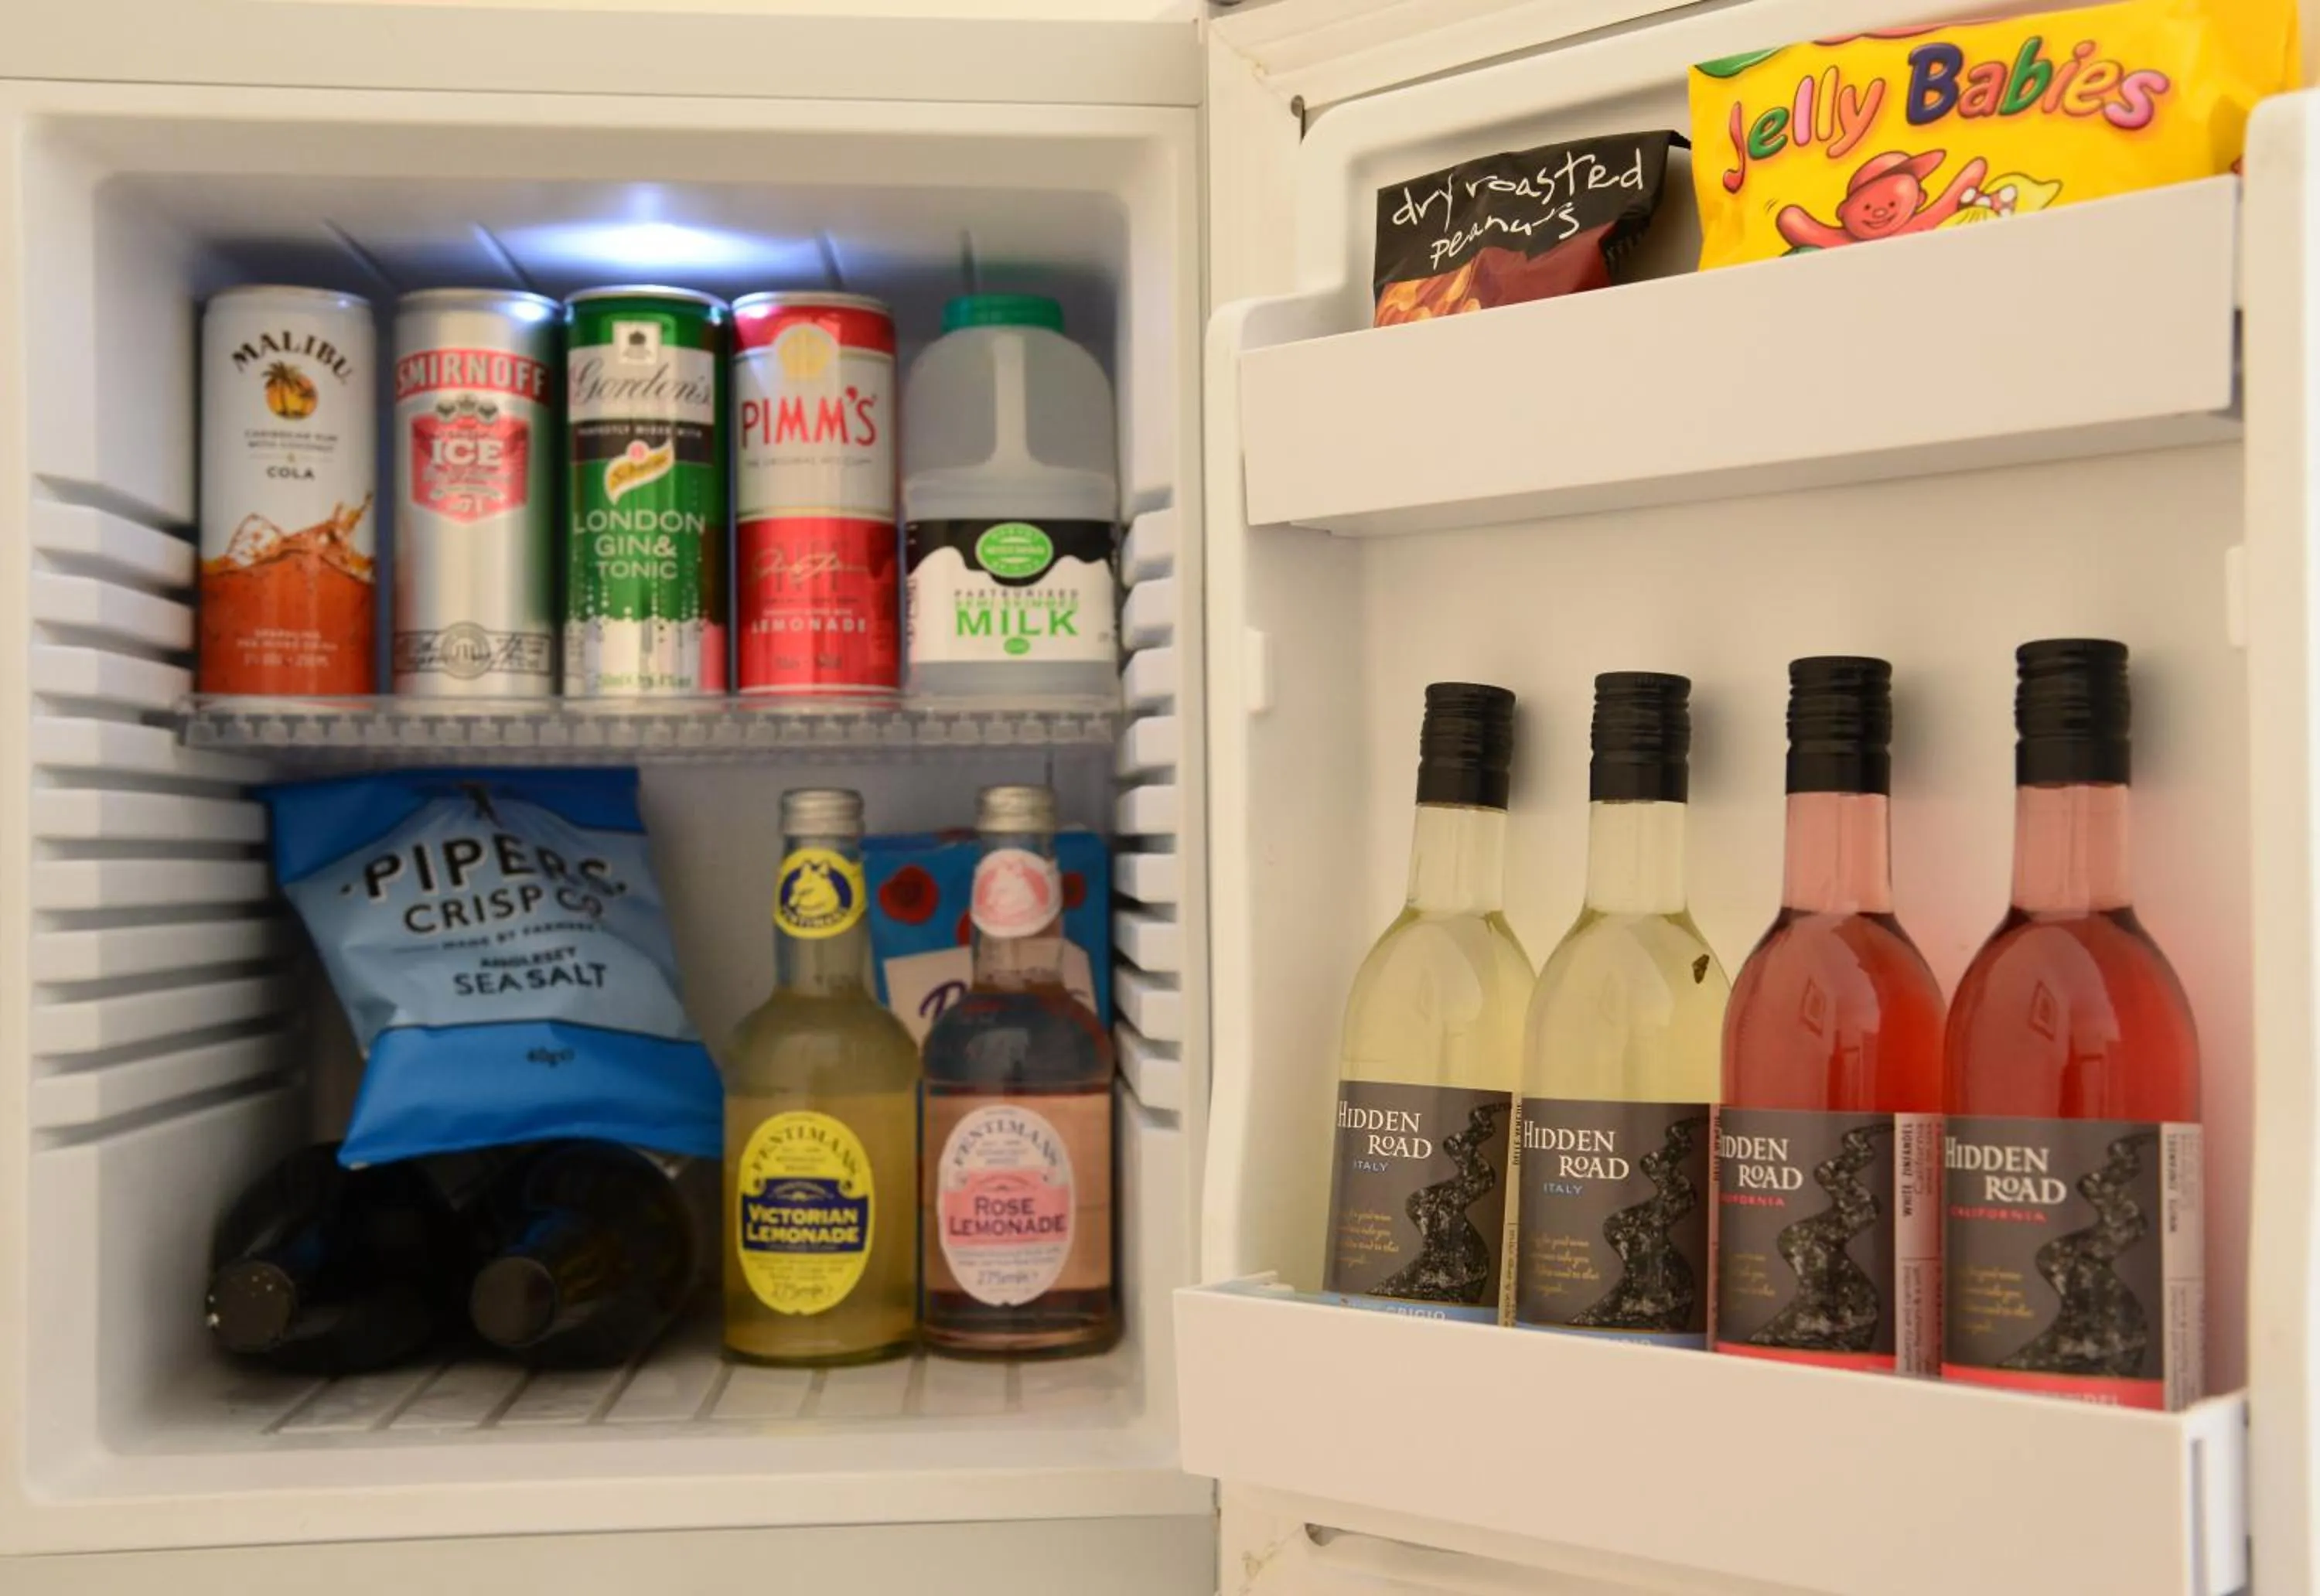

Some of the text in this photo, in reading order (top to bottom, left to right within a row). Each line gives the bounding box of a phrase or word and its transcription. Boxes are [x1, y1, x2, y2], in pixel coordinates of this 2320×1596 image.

[1722, 36, 2170, 194] Jelly Babies
[1392, 148, 1643, 232] dry roasted
[231, 330, 353, 384] MALIBU
[397, 352, 546, 397] SMIRNOFF
[571, 357, 711, 404] Gordon's
[742, 385, 877, 449] PIMM'S
[432, 438, 504, 466] ICE
[267, 466, 316, 480] COLA
[572, 509, 705, 534] LONDON
[595, 560, 678, 579] TONIC
[751, 618, 866, 633] LEMONADE
[956, 609, 1077, 636] MILK
[363, 834, 616, 898] PIPERS
[404, 885, 543, 933] CRISP
[453, 962, 607, 996] SEA SALT
[1338, 1100, 1422, 1133] HIDDEN
[954, 1119, 1057, 1166] FENTIMANS
[1367, 1134, 1432, 1159] ROAD
[1524, 1120, 1615, 1152] HIDDEN
[1354, 1160, 1388, 1171] ITALY
[1558, 1155, 1629, 1179] ROAD
[1944, 1136, 2049, 1173] HIDDEN
[1739, 1165, 1803, 1190] ROAD
[1902, 1123, 1913, 1216] WHITE ZINFANDEL
[1544, 1183, 1582, 1195] ITALY
[1985, 1175, 2067, 1204] ROAD
[747, 1203, 858, 1225] VICTORIAN
[975, 1196, 1035, 1216] ROSE
[746, 1223, 859, 1243] LEMONADE
[949, 1214, 1066, 1236] LEMONADE
